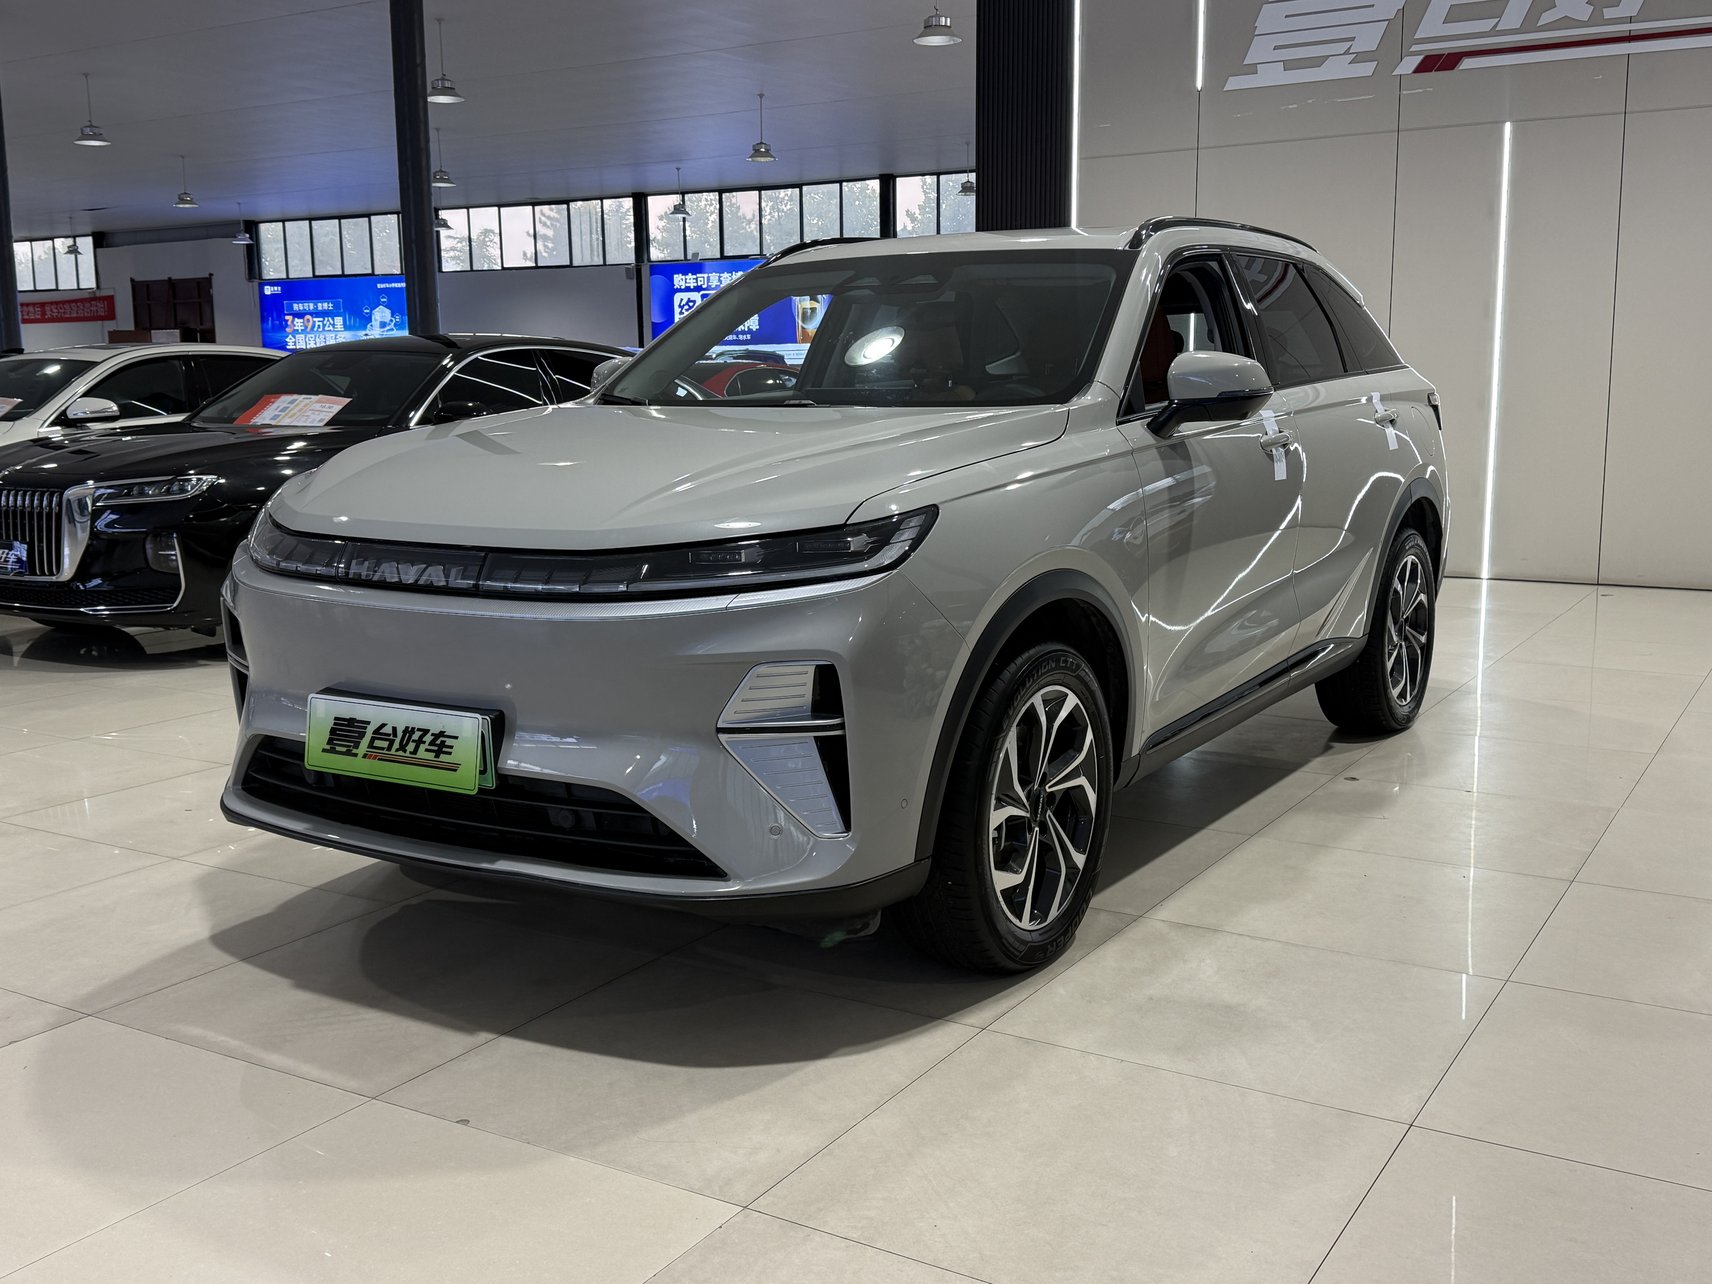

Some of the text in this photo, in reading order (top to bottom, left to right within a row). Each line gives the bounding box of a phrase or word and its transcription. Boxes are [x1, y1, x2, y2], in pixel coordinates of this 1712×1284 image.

[285, 315, 344, 333] 3年9万公里
[349, 558, 472, 588] HAVAL
[321, 716, 459, 759] 壹台好车
